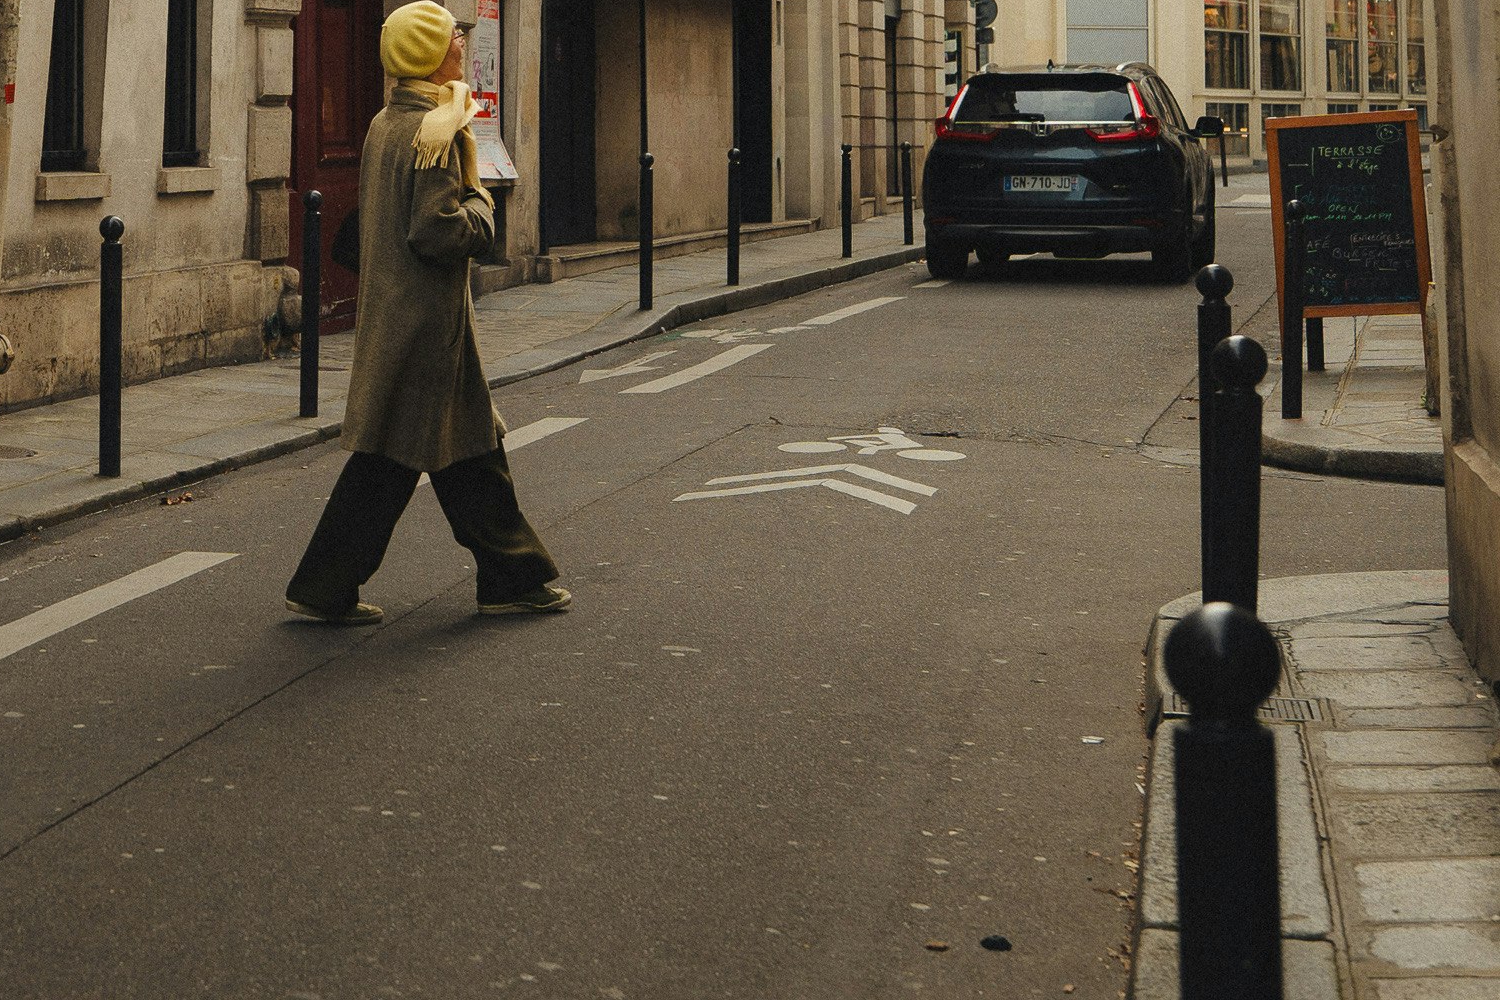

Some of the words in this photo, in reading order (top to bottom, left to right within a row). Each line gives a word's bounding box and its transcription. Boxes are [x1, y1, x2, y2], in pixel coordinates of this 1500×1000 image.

[1318, 144, 1385, 157] TERRASSE
[1012, 177, 1071, 189] GN-710-JD
[1328, 203, 1359, 213] OPEN
[1306, 235, 1331, 249] AFÉ
